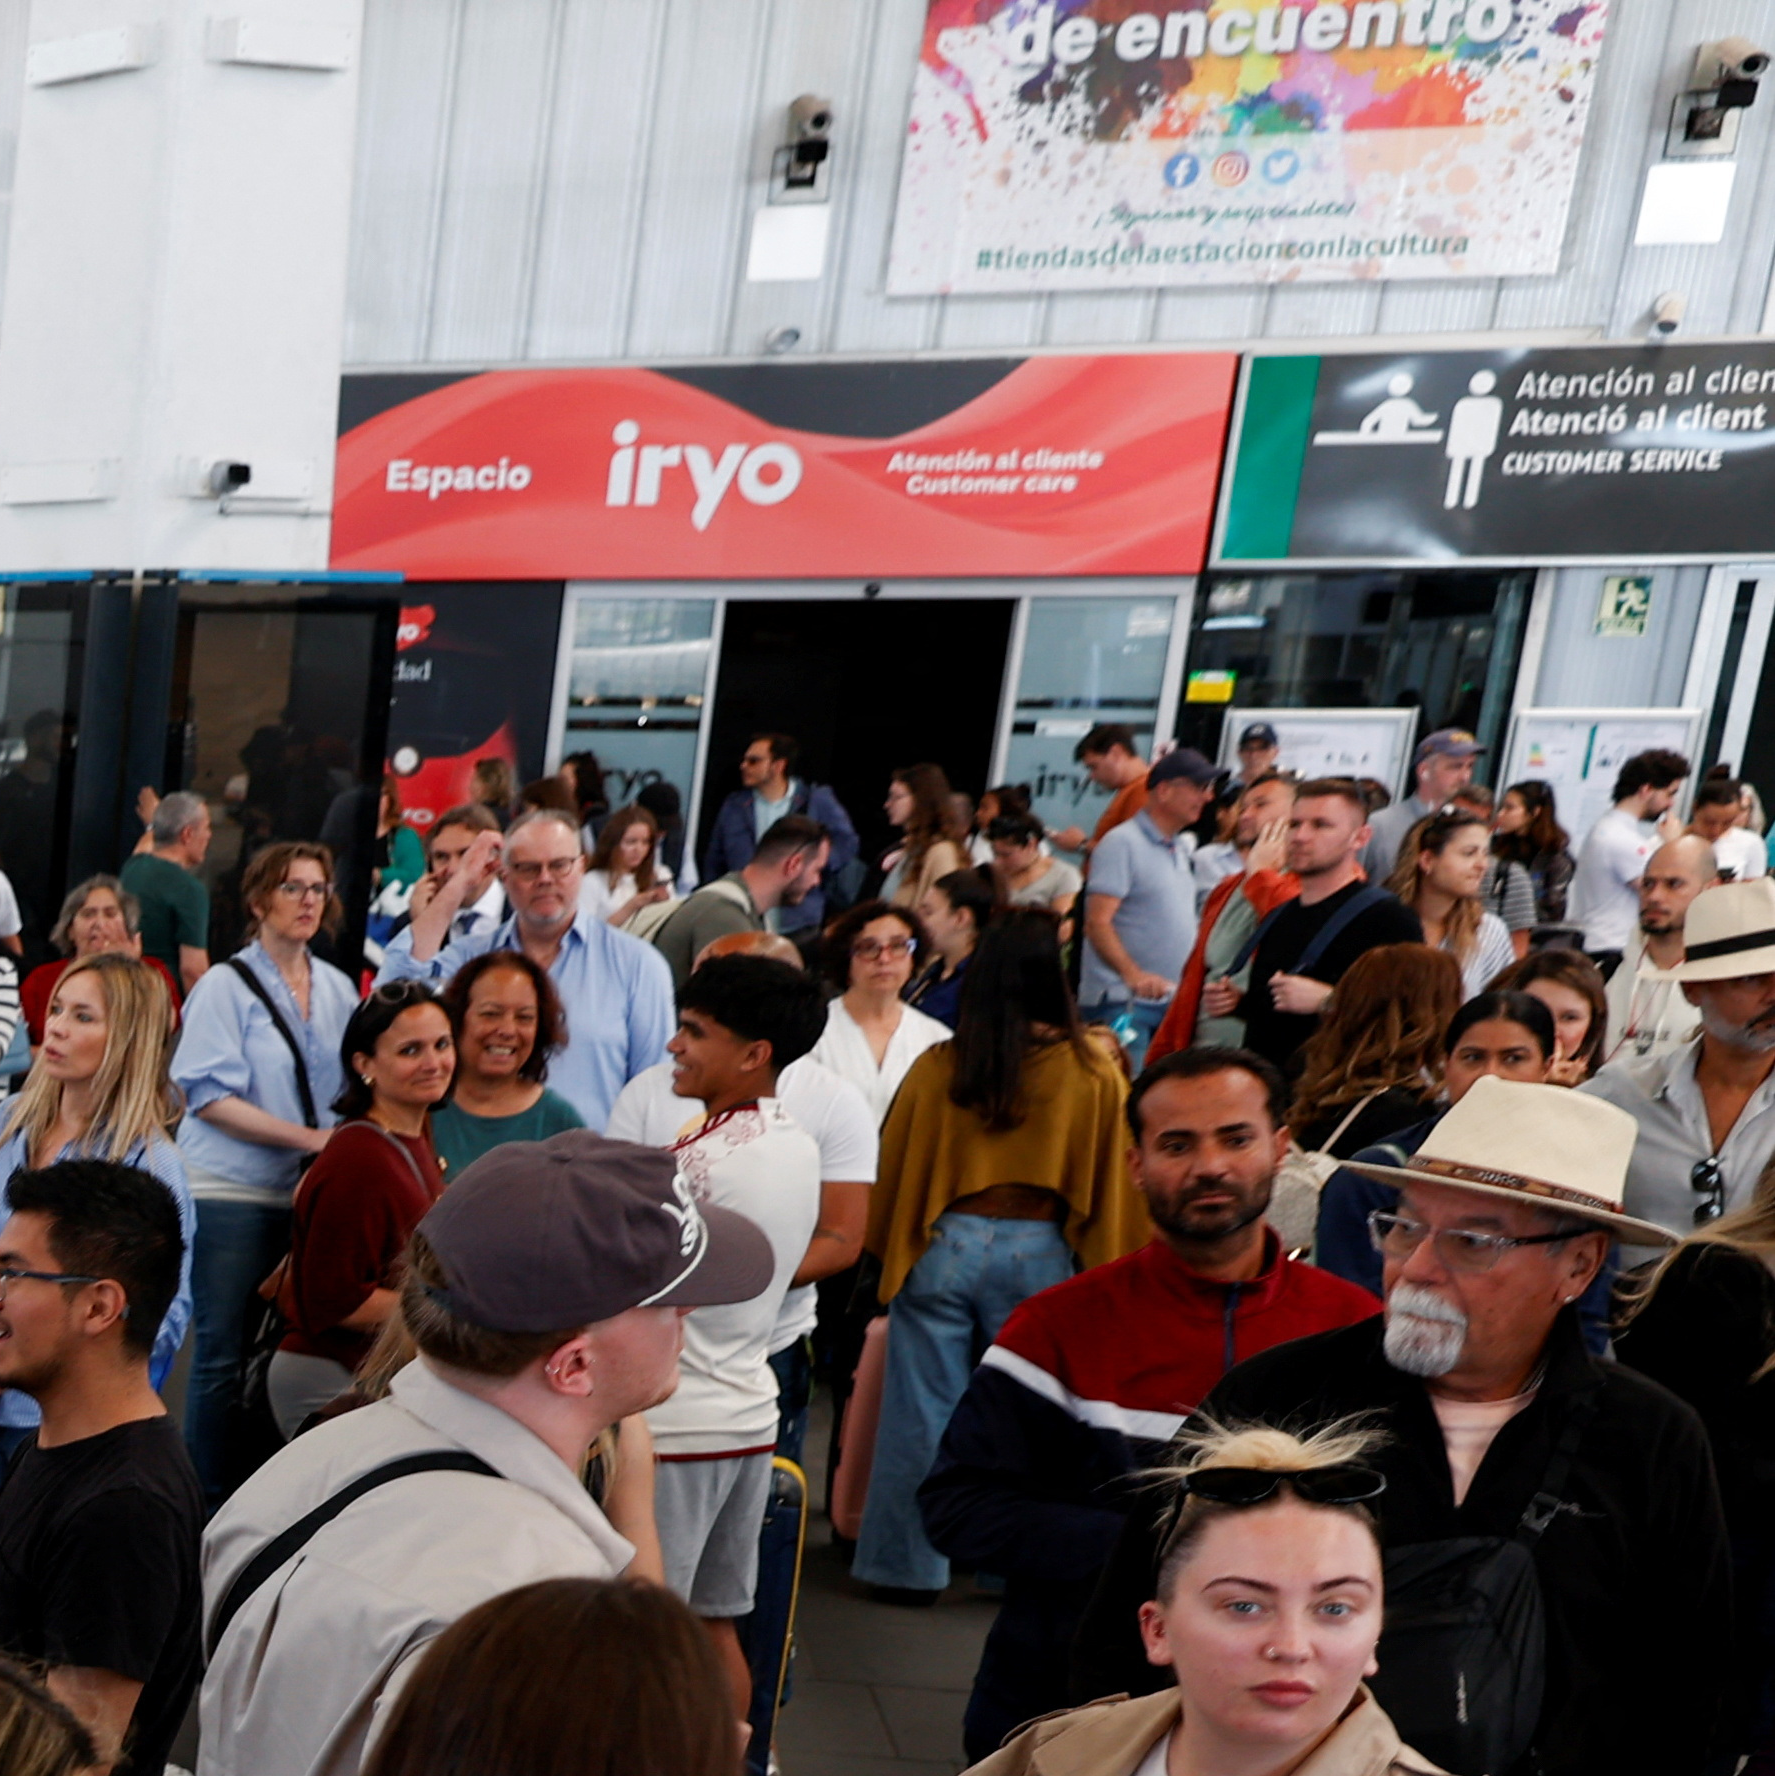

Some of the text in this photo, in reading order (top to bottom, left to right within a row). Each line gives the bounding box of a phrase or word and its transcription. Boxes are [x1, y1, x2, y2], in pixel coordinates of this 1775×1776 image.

[1009, 0, 1514, 64] de encuentro
[1516, 365, 1654, 400] Atención
[1665, 366, 1696, 396] al
[1508, 401, 1766, 436] Atenció al client
[386, 456, 532, 500] Espacio
[605, 419, 803, 532] iryo
[887, 449, 1104, 473] Atención al cliente
[1502, 449, 1722, 476] CUSTOMER SERVICE
[906, 474, 1078, 495] Customer care
[1036, 763, 1115, 807] iry
